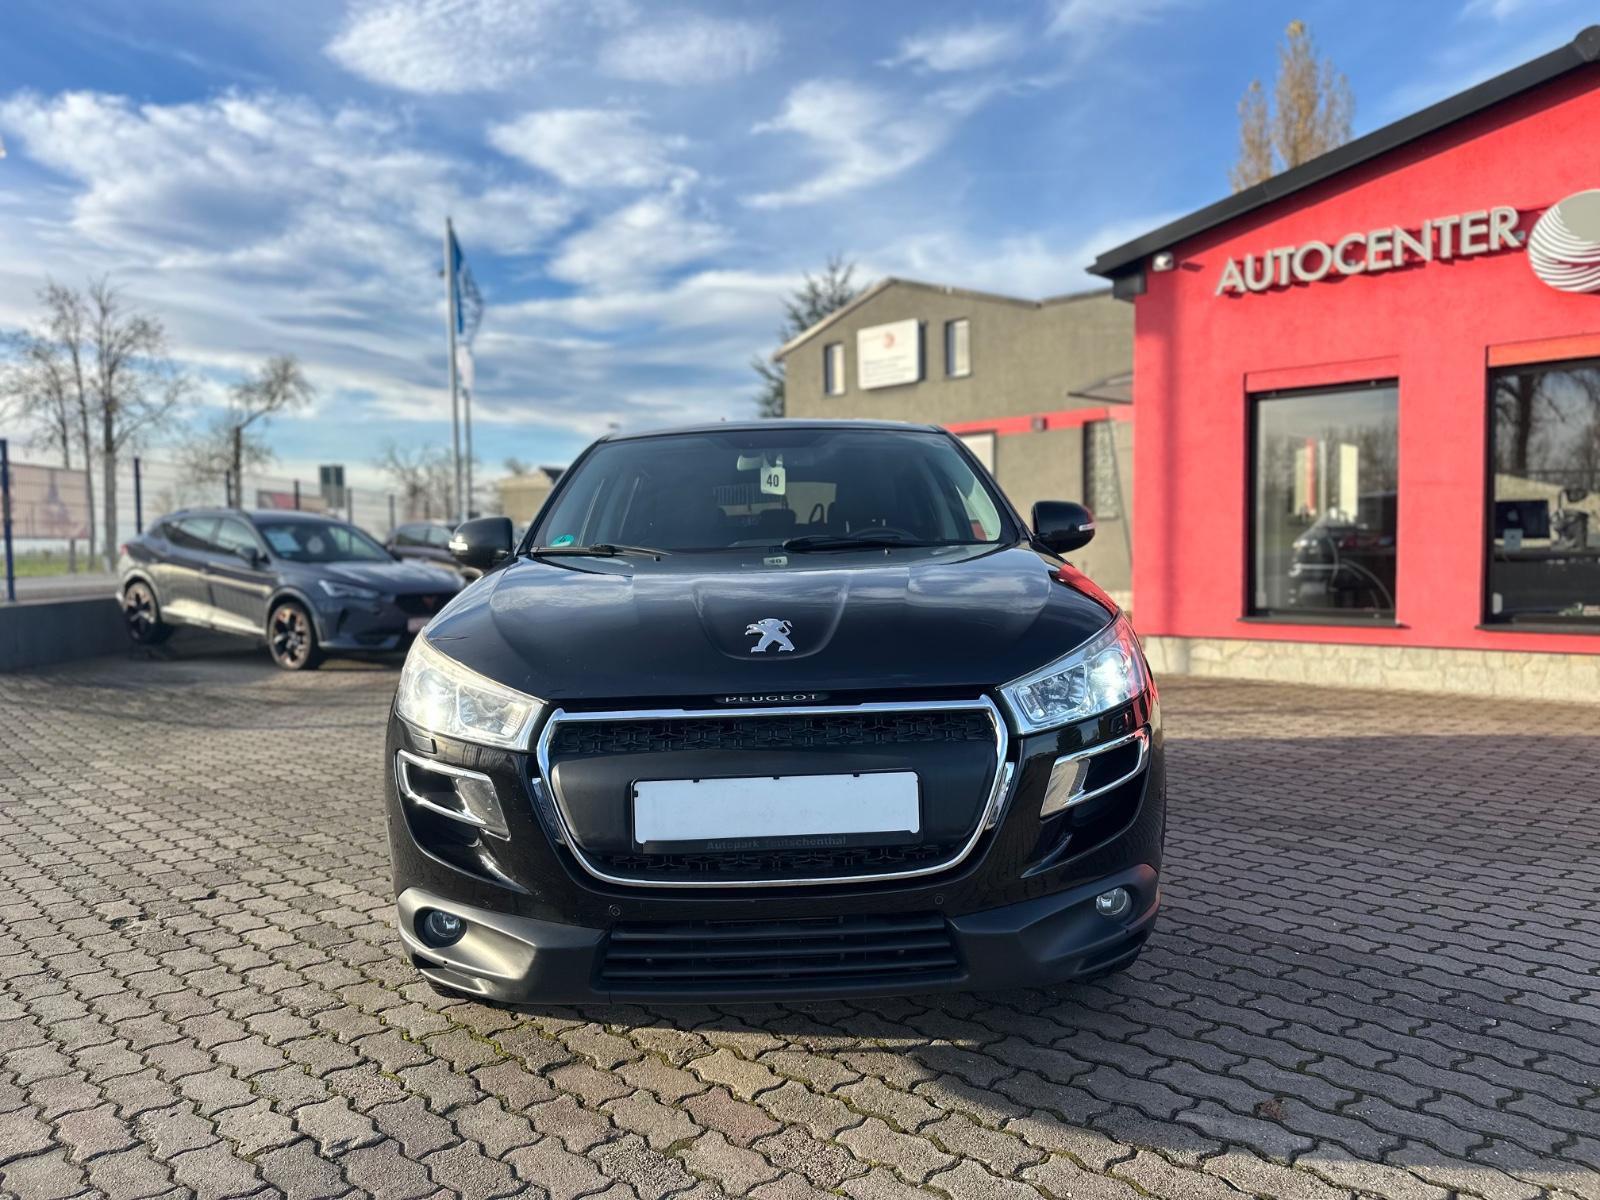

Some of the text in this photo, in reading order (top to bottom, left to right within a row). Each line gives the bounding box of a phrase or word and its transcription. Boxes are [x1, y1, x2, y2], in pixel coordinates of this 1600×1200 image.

[1215, 206, 1521, 296] AUTOCENTER
[766, 474, 780, 487] 40
[725, 694, 816, 703] PEUGEOT
[706, 840, 760, 850] Autopark
